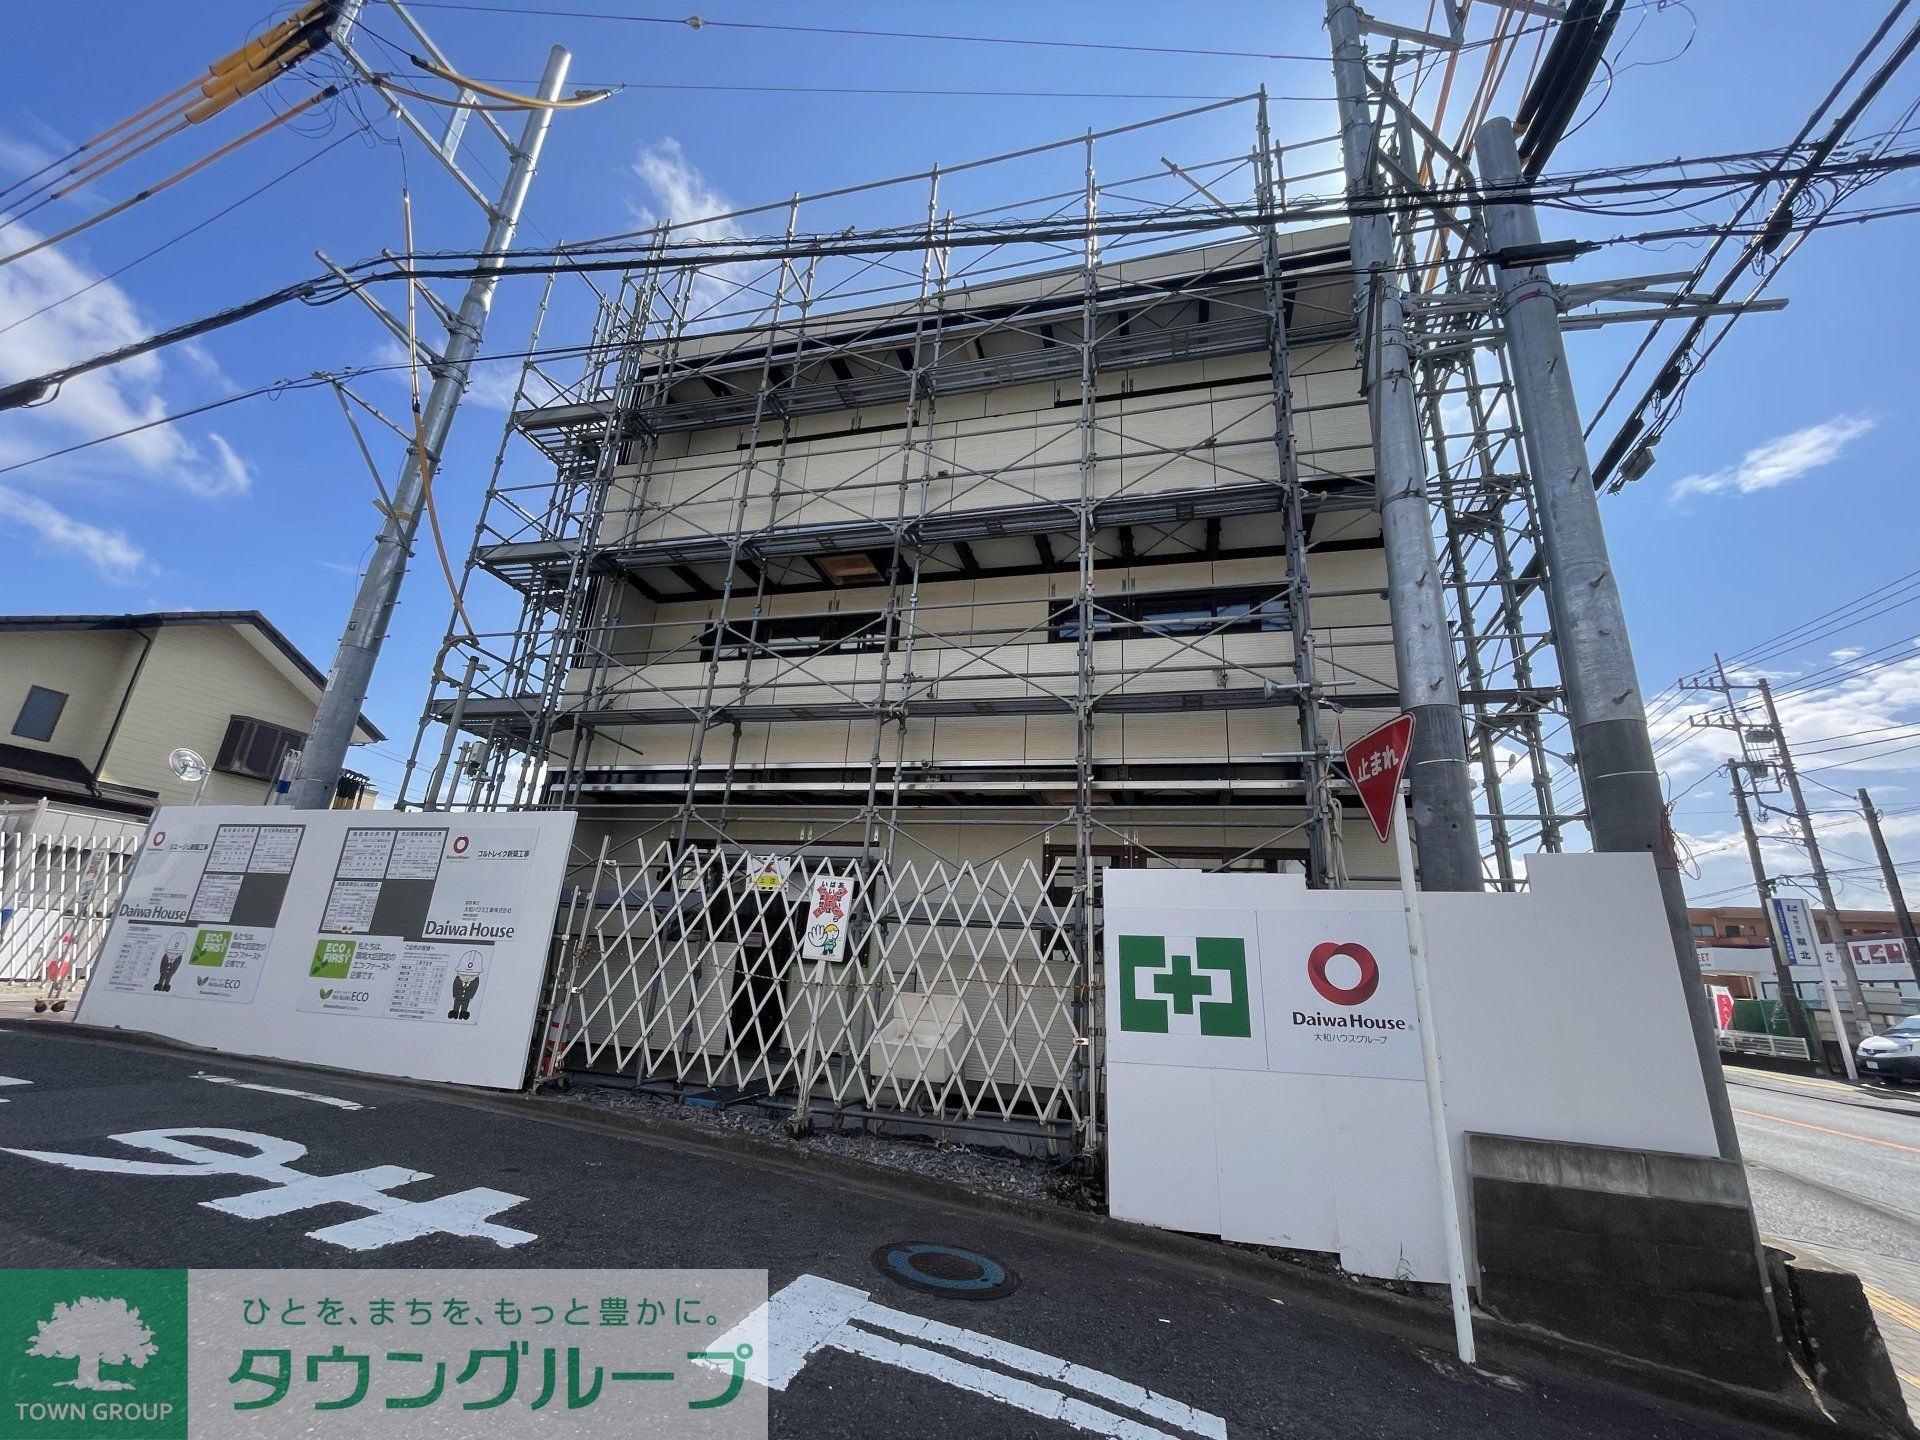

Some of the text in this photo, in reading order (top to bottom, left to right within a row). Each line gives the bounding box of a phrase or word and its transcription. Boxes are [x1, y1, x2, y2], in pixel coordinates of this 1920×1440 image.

[1357, 745, 1399, 783] 止まれ
[119, 904, 187, 920] Daiwa House
[425, 920, 515, 938] Daiwa House
[205, 933, 223, 942] ECO
[325, 943, 346, 952] ECO
[322, 953, 351, 963] FIRST
[224, 980, 241, 988] ECO
[351, 992, 369, 1002] ECO
[1292, 1012, 1406, 1030] Daiwa House
[1314, 1033, 1388, 1044] 大和ハウスグループ
